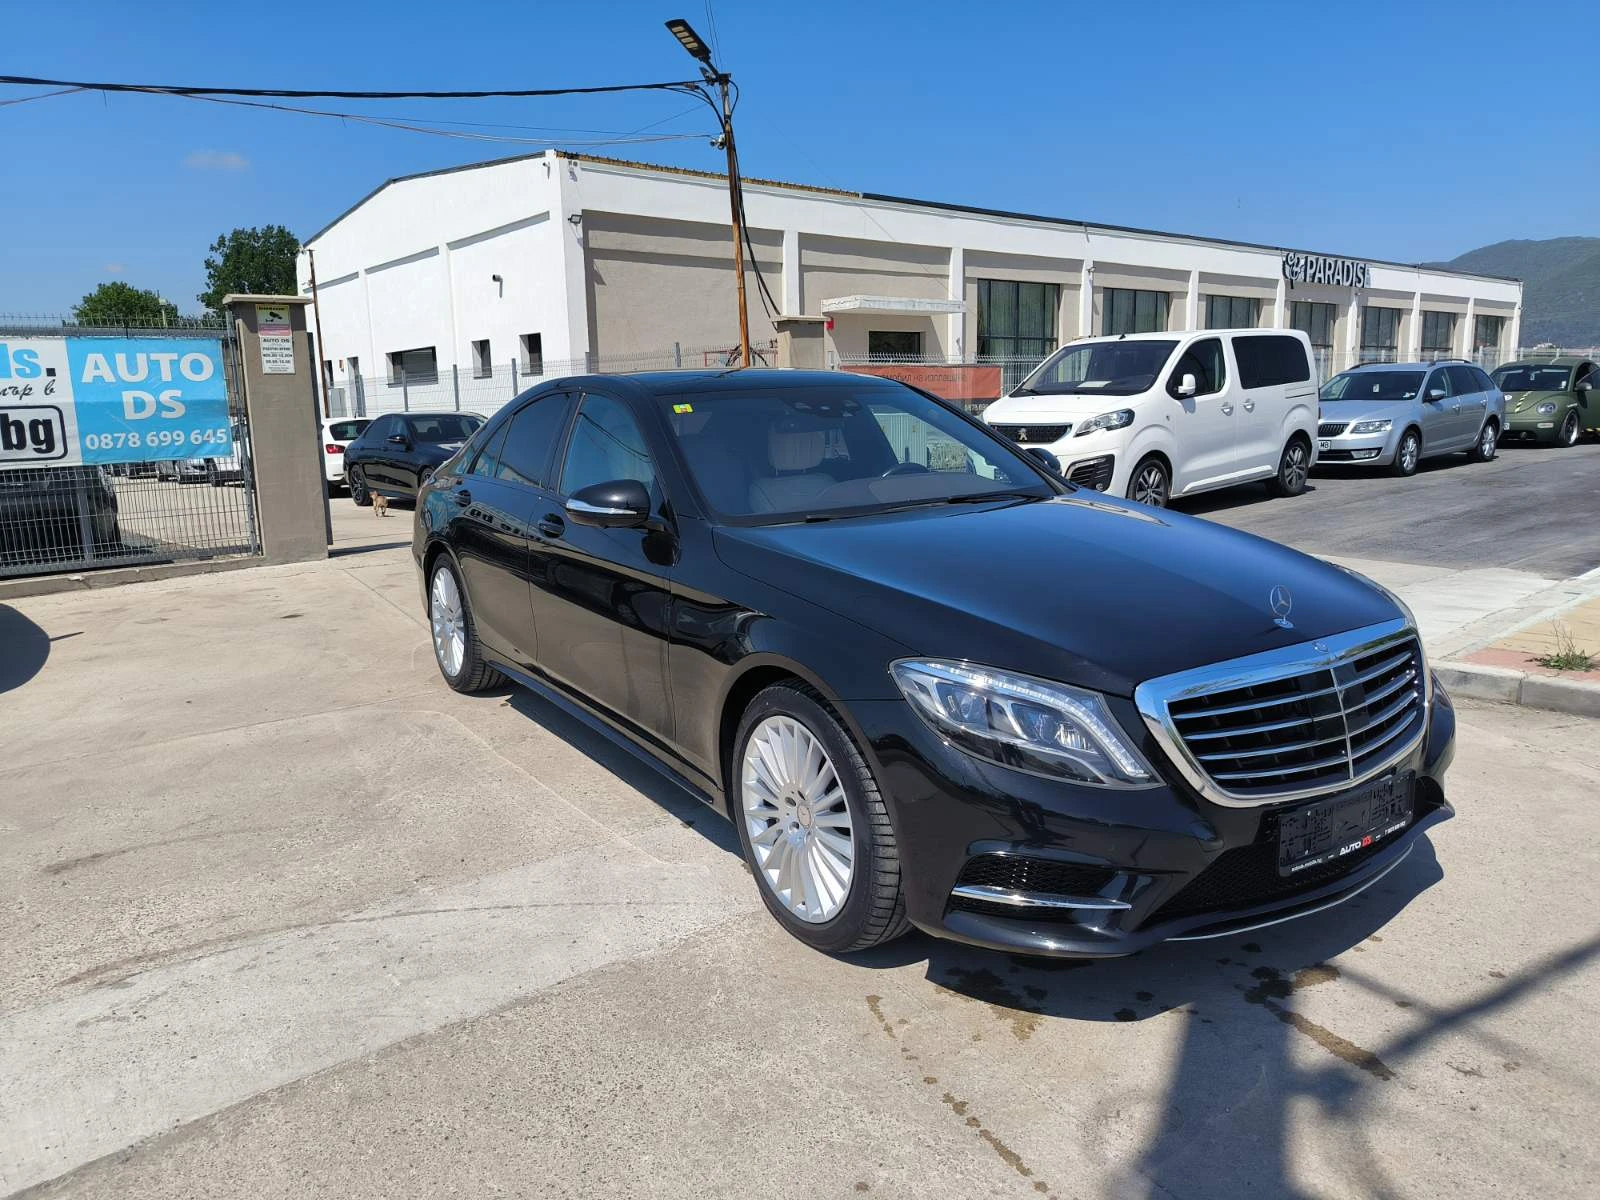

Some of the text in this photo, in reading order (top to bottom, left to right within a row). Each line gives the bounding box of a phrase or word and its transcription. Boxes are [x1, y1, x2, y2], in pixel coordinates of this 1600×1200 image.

[82, 352, 214, 383] AUTO
[122, 389, 186, 420] DS
[85, 428, 228, 450] 0878 699 645
[1339, 841, 1362, 856] AUTO
